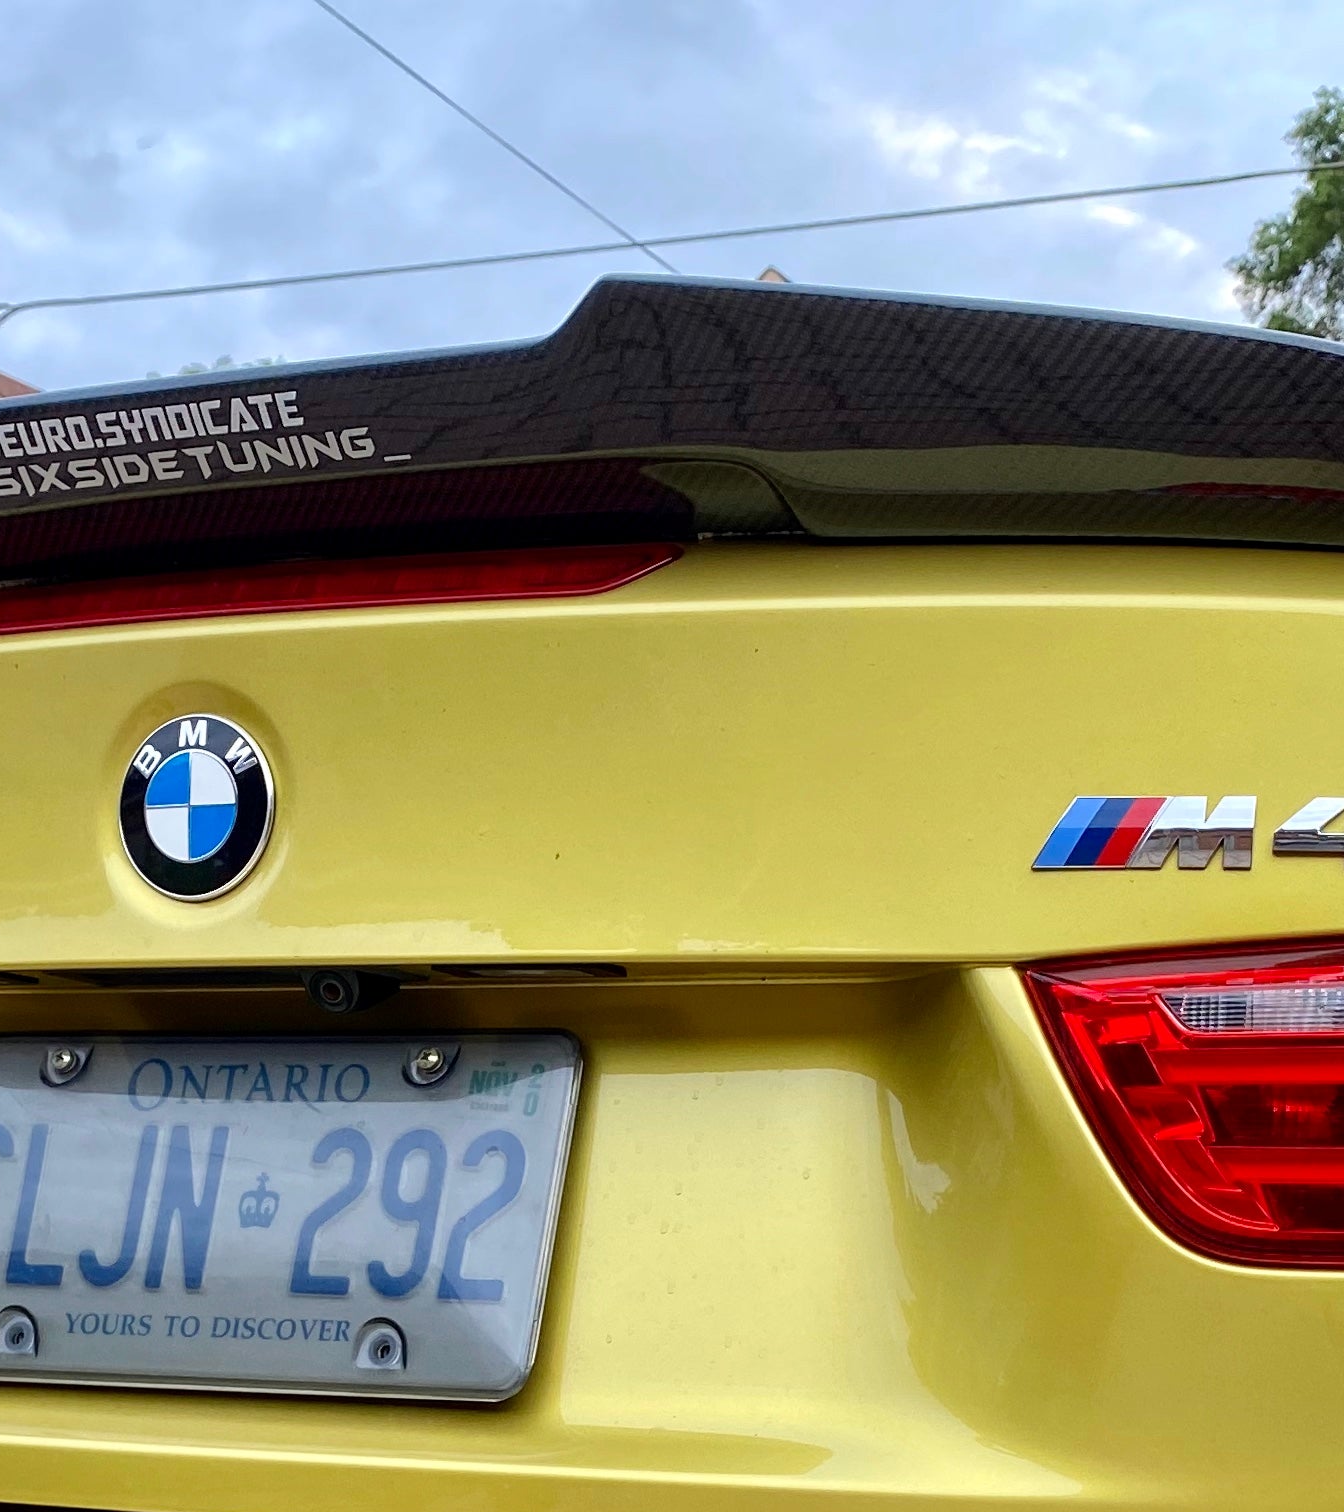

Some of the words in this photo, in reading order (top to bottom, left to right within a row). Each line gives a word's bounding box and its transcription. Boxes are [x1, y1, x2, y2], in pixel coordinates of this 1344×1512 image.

[133, 719, 258, 780] BMW
[127, 1058, 371, 1113] ONTARIO
[289, 1126, 527, 1302] 292
[64, 1313, 153, 1337] YOURS
[164, 1315, 201, 1338] TO
[210, 1316, 351, 1342] DISCOVER
